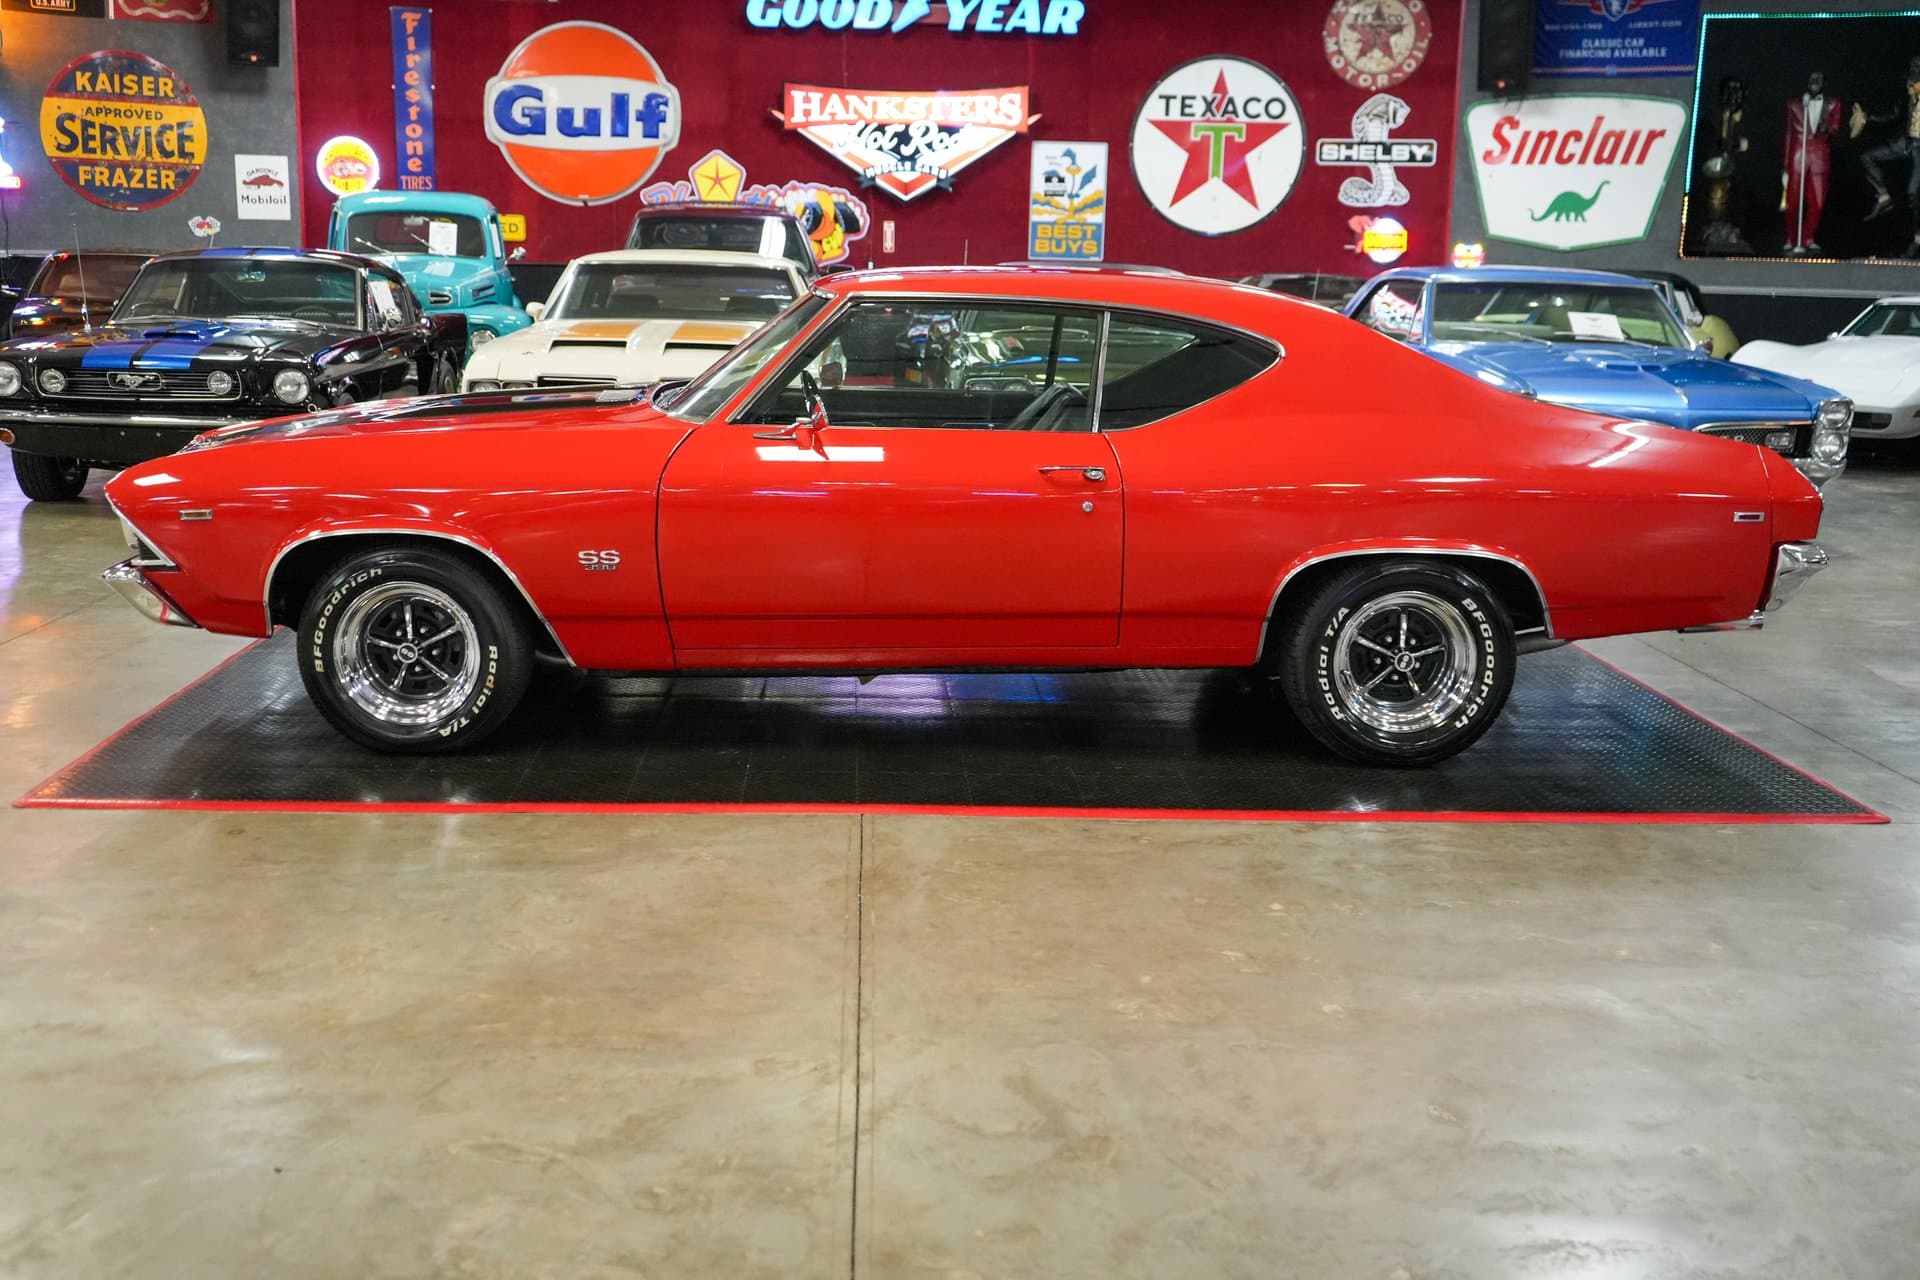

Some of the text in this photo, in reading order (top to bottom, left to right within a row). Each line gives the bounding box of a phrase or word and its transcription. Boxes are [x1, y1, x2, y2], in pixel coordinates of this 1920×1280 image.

[1559, 47, 1668, 59] FINANCING AVAILABLE
[1581, 37, 1645, 48] CLASSIC CAR
[75, 71, 175, 98] KAISER
[400, 12, 424, 173] Firestone
[84, 106, 163, 121] APPROVED
[493, 84, 669, 139] Gulf
[790, 90, 1022, 126] HANKSTERS
[1159, 94, 1287, 120] TEXACO
[55, 112, 195, 160] SERVICE
[1482, 115, 1667, 166] Sinclair
[1191, 122, 1246, 179] T
[1321, 144, 1432, 162] SHELBY
[78, 165, 176, 190] FRAZER
[866, 161, 912, 178] MUSCLE
[401, 176, 432, 190] TIRES
[241, 195, 286, 205] Mobiloil
[1037, 224, 1097, 239] BEST
[1035, 240, 1098, 255] BUYS
[578, 549, 621, 564] SS
[313, 567, 382, 673] BFGoodrich
[1318, 607, 1350, 720] Radial T/A
[1455, 598, 1495, 729] BFGoodrich
[439, 645, 499, 737] Radial T/A
